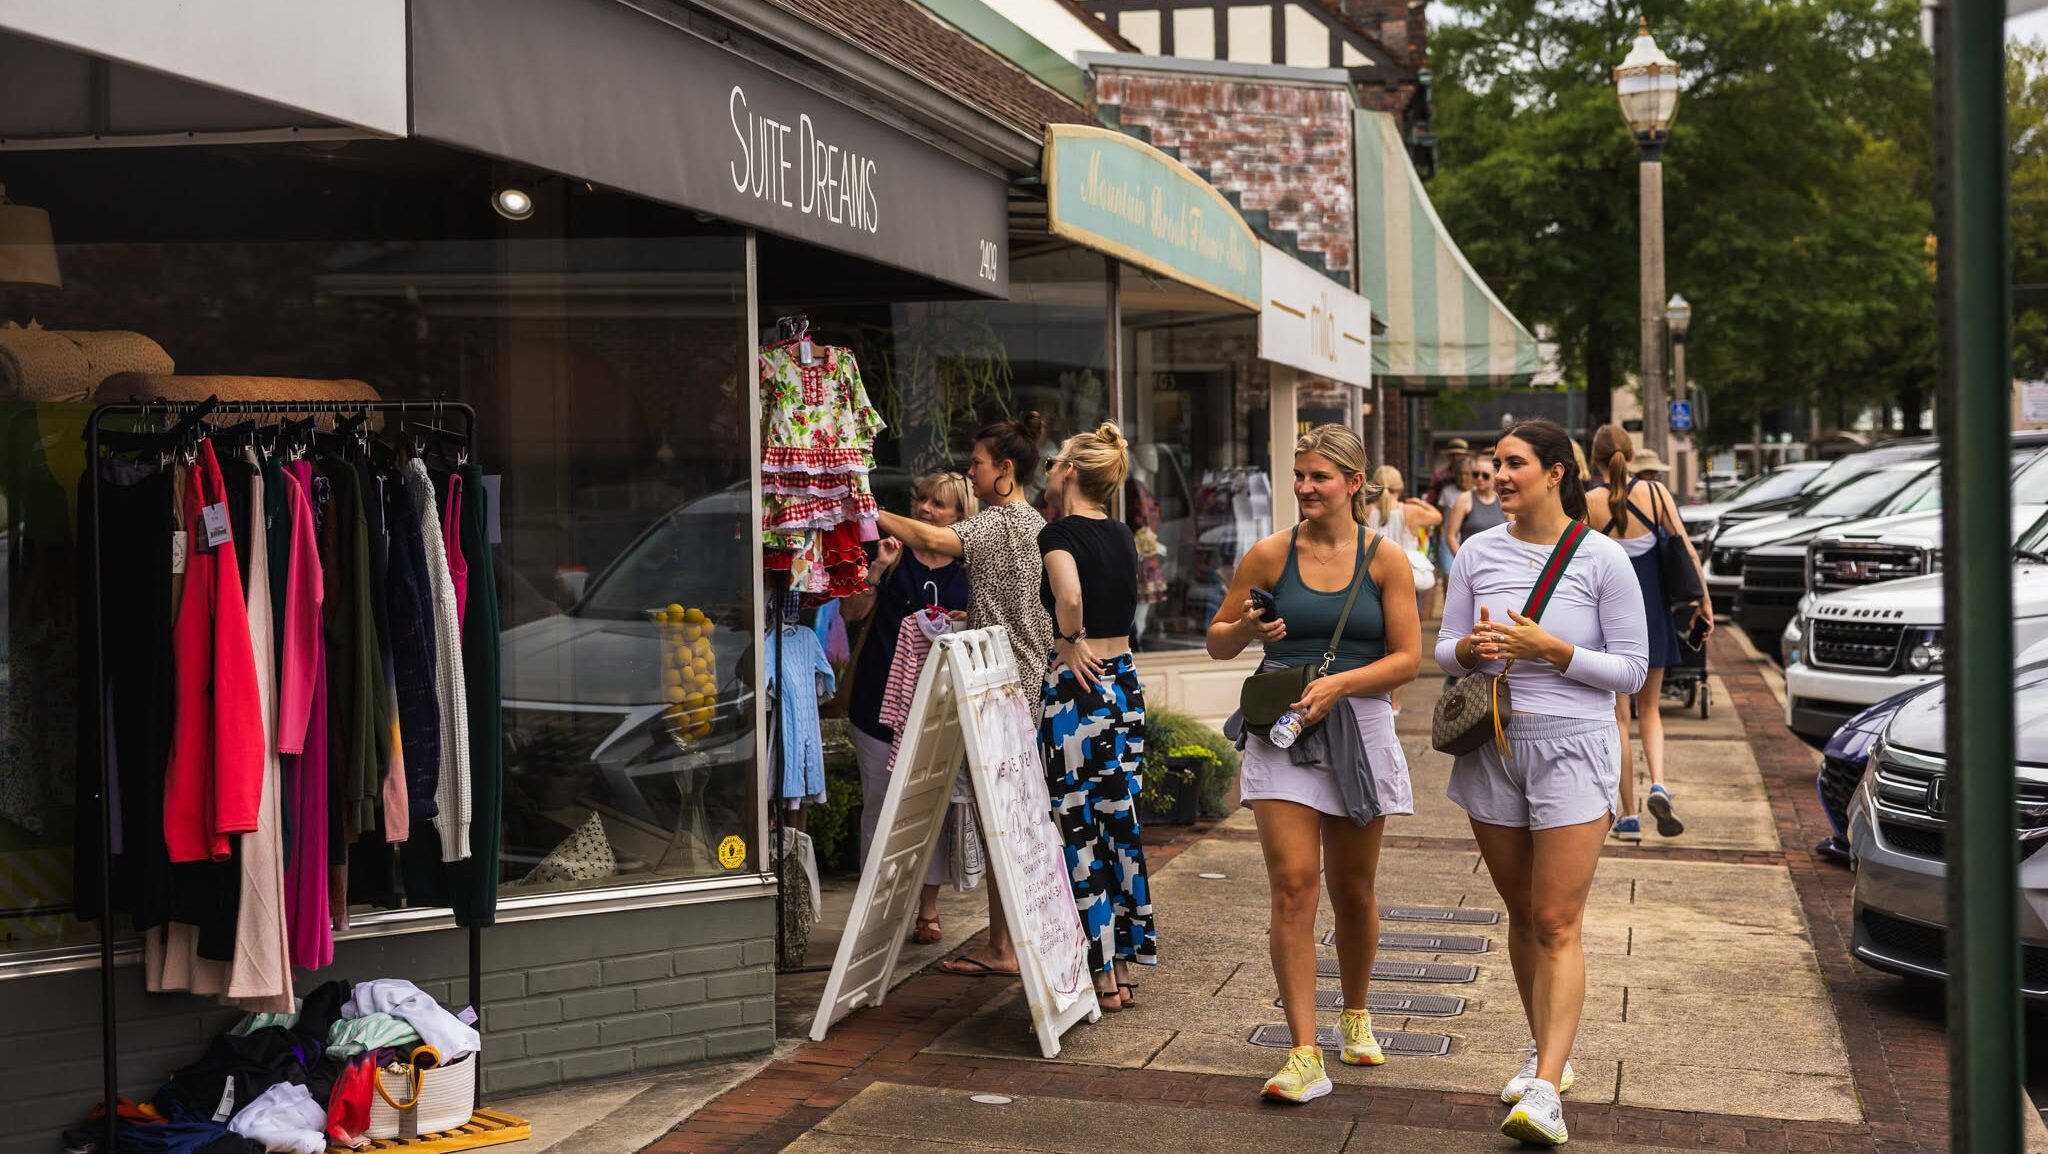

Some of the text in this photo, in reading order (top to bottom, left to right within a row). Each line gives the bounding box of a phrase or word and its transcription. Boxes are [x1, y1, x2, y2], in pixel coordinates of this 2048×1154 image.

[730, 85, 878, 234] SUITE DREAMS
[980, 239, 998, 282] 2409
[1818, 606, 1904, 619] LAND ROVER
